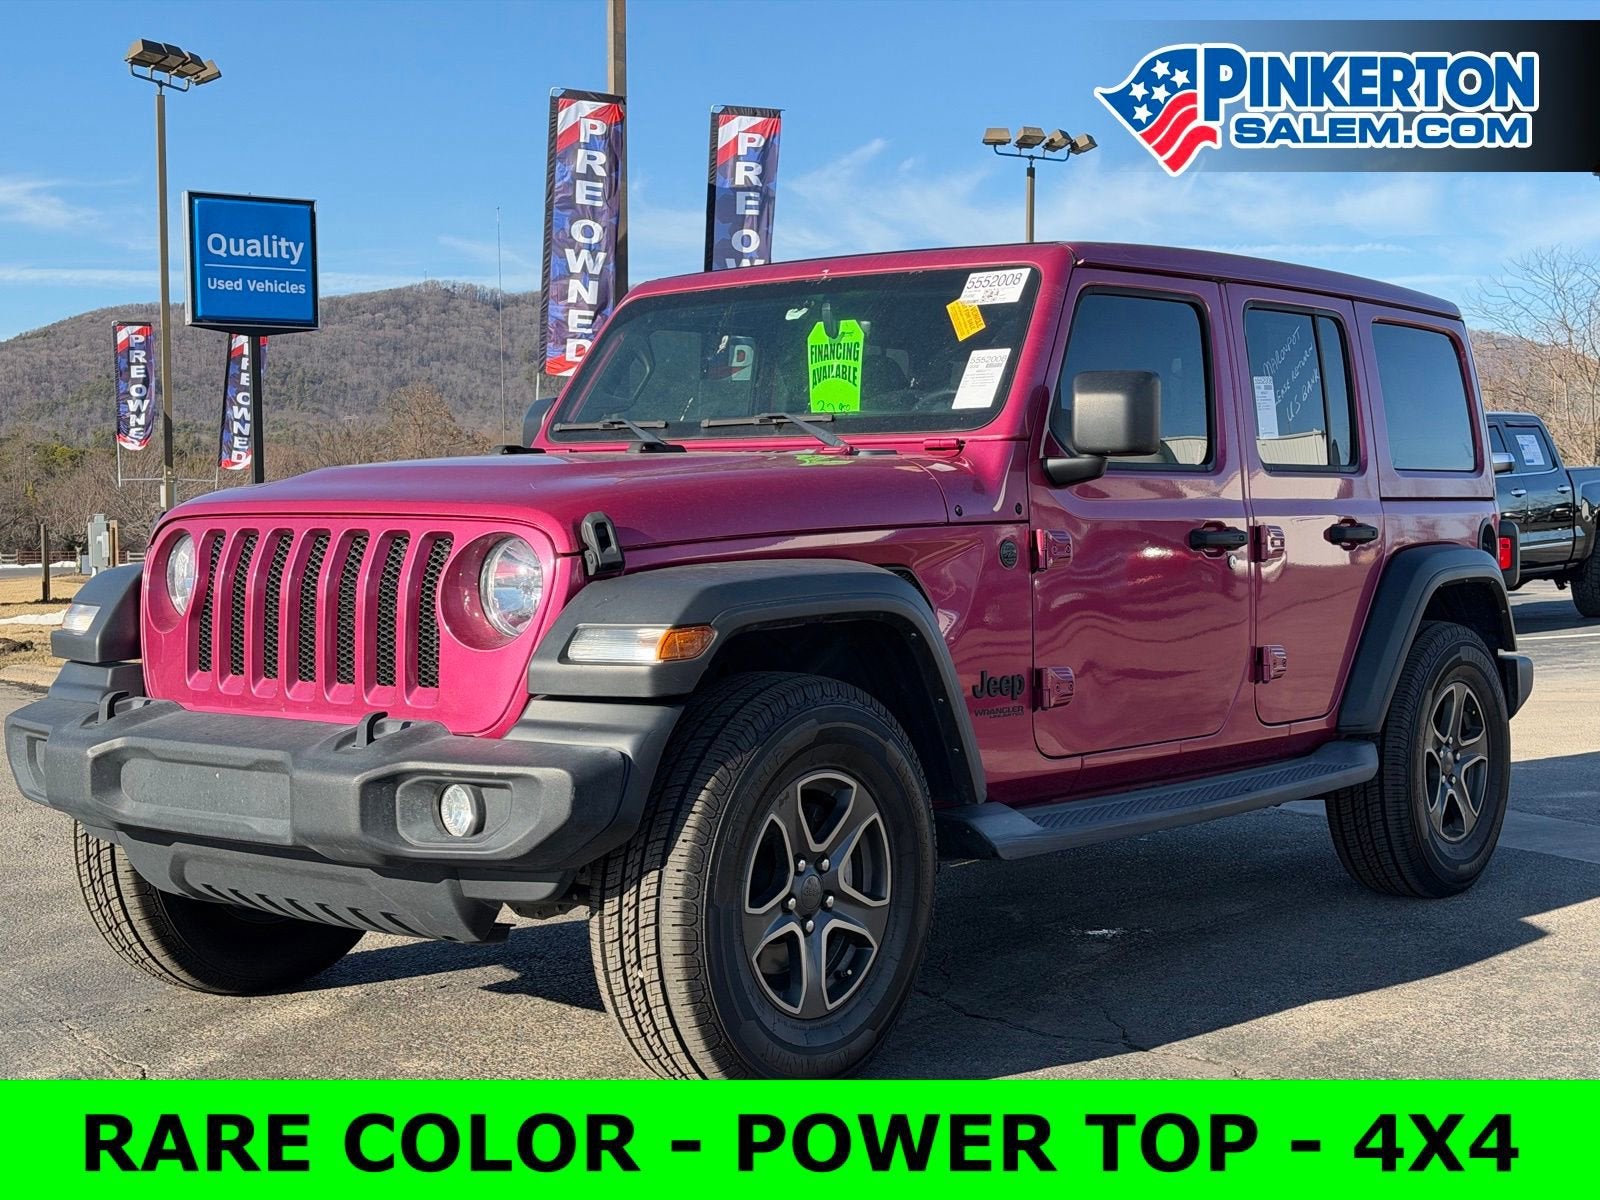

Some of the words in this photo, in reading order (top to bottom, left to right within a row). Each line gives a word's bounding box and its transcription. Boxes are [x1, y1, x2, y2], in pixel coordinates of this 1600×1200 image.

[575, 117, 608, 208] PRE
[733, 131, 764, 216] PRE
[206, 232, 305, 266] Quality
[207, 277, 243, 291] Used
[247, 279, 306, 294] Vehicles
[564, 218, 608, 364] OWNED
[966, 272, 1023, 290] 5552008
[129, 334, 148, 379] PRE
[810, 341, 860, 365] FINANCING
[969, 354, 1008, 365] 5552008
[811, 364, 858, 390] AVAILABLE
[971, 670, 1025, 701] Jeep
[974, 705, 1025, 717] WRANGLER
